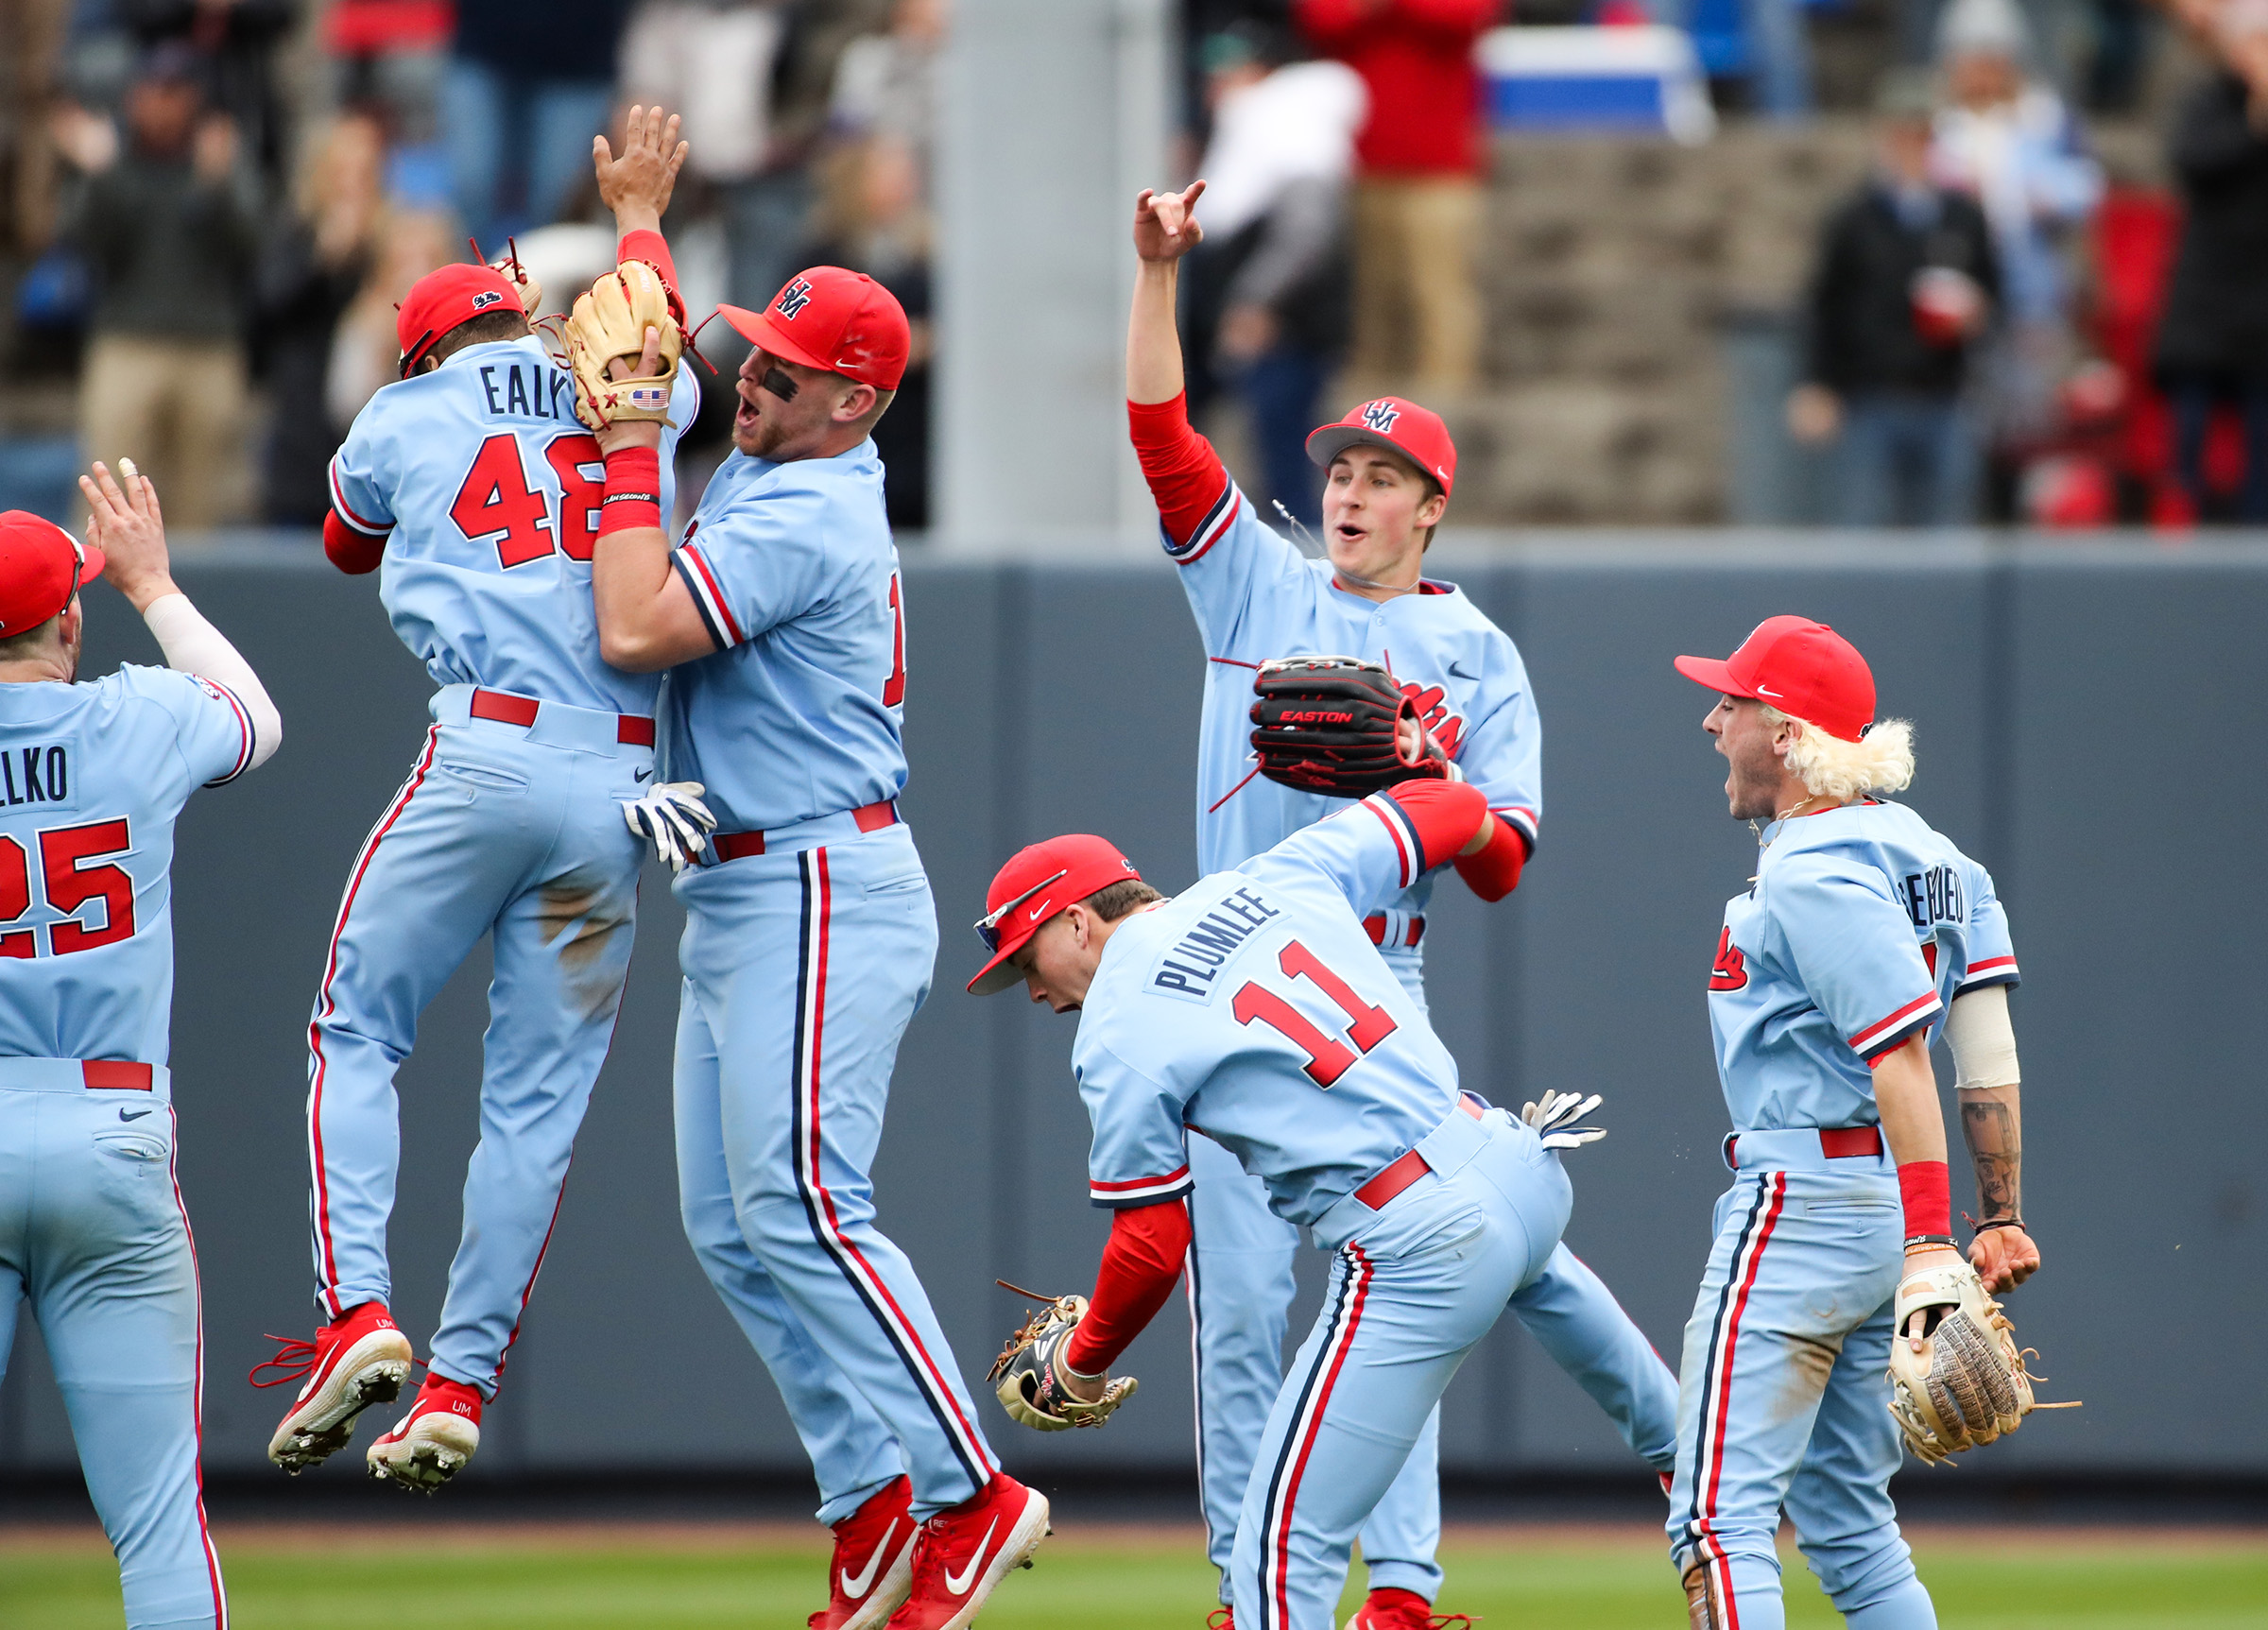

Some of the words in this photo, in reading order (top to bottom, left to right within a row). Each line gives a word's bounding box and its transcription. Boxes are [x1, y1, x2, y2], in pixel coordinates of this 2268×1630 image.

[479, 364, 567, 420] EALY
[1362, 401, 1400, 434] UM
[446, 430, 607, 573] 48
[1280, 710, 1353, 723] EASTON
[1154, 886, 1280, 997] PLUMLEE
[1229, 936, 1401, 1091] 11
[452, 1399, 472, 1416] UM
